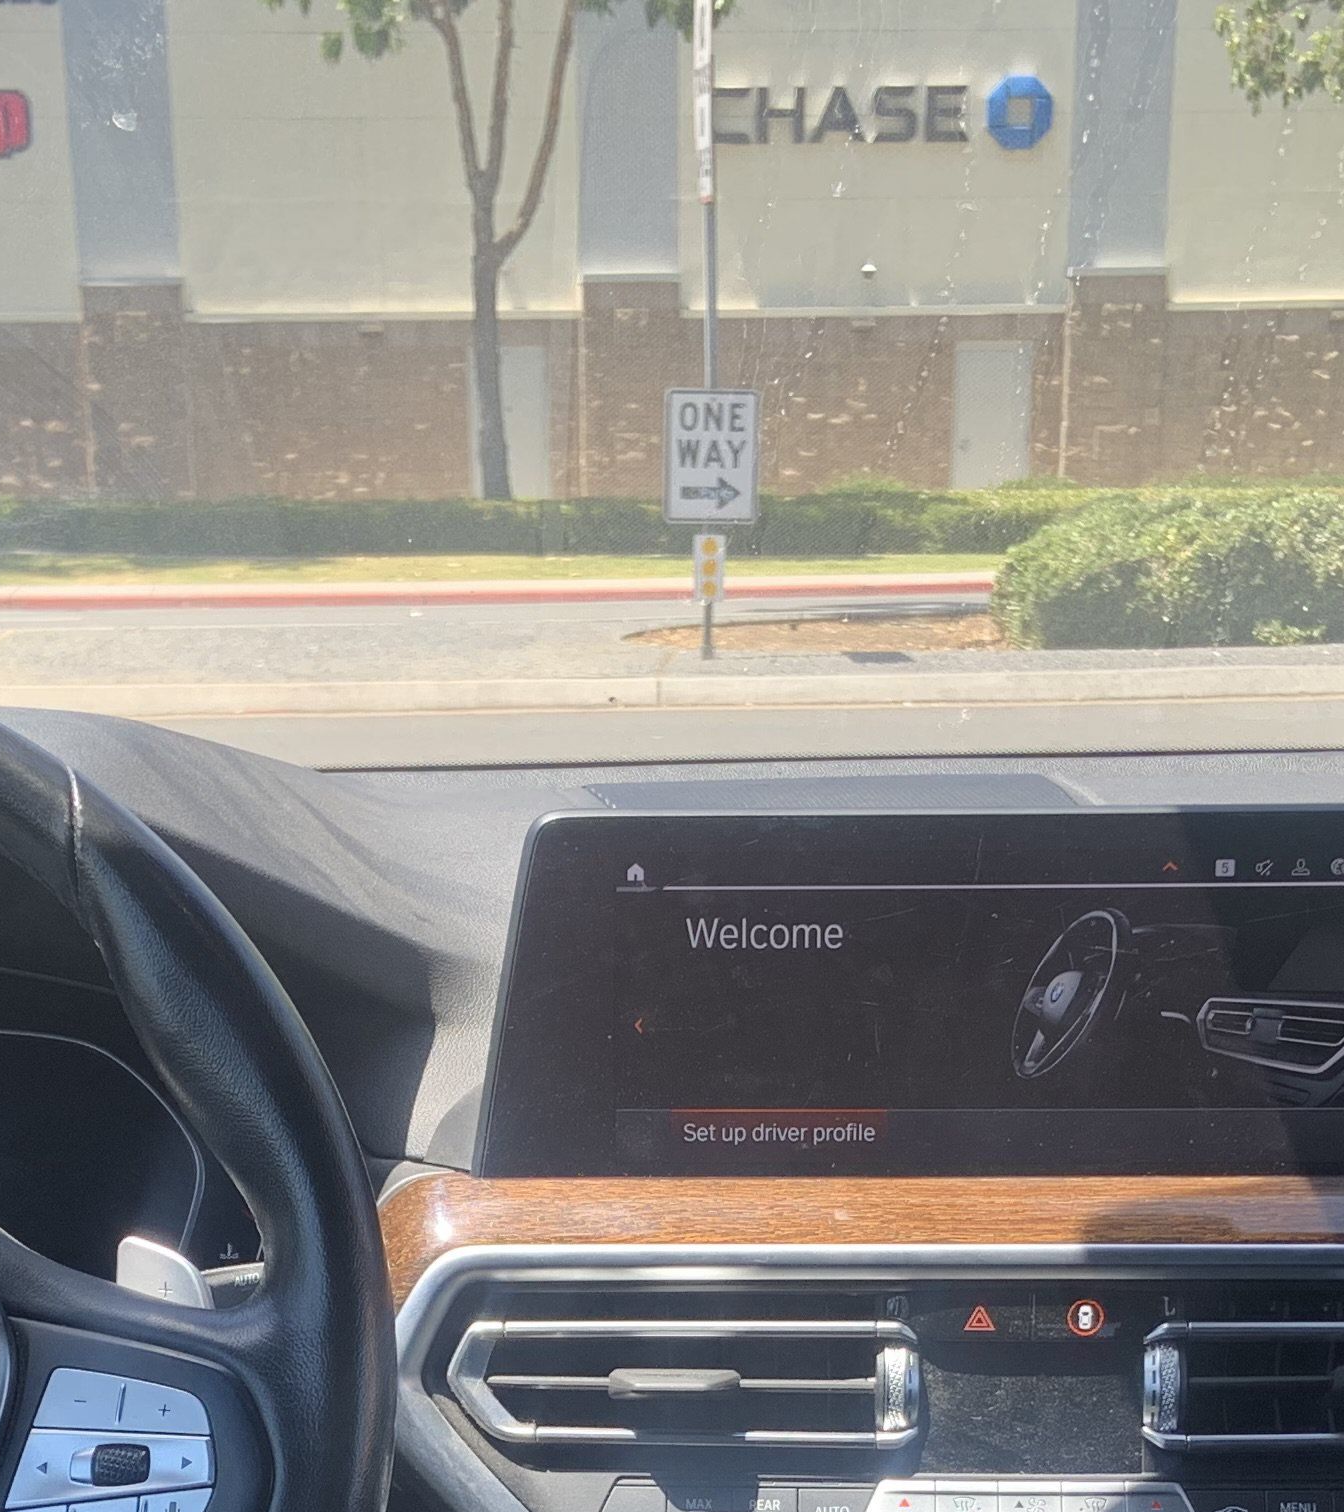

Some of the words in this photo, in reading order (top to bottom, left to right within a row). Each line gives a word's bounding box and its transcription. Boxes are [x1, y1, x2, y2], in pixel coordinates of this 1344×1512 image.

[712, 84, 968, 144] CHASE
[679, 402, 746, 432] ONE
[677, 439, 746, 469] WAY
[685, 917, 844, 950] Welcome
[683, 1122, 716, 1142] Set
[721, 1125, 747, 1146] up
[751, 1122, 808, 1142] driver
[812, 1122, 877, 1146] profile
[234, 1272, 260, 1287] AUTO
[685, 1499, 712, 1510] MAX
[748, 1499, 781, 1511] REAR
